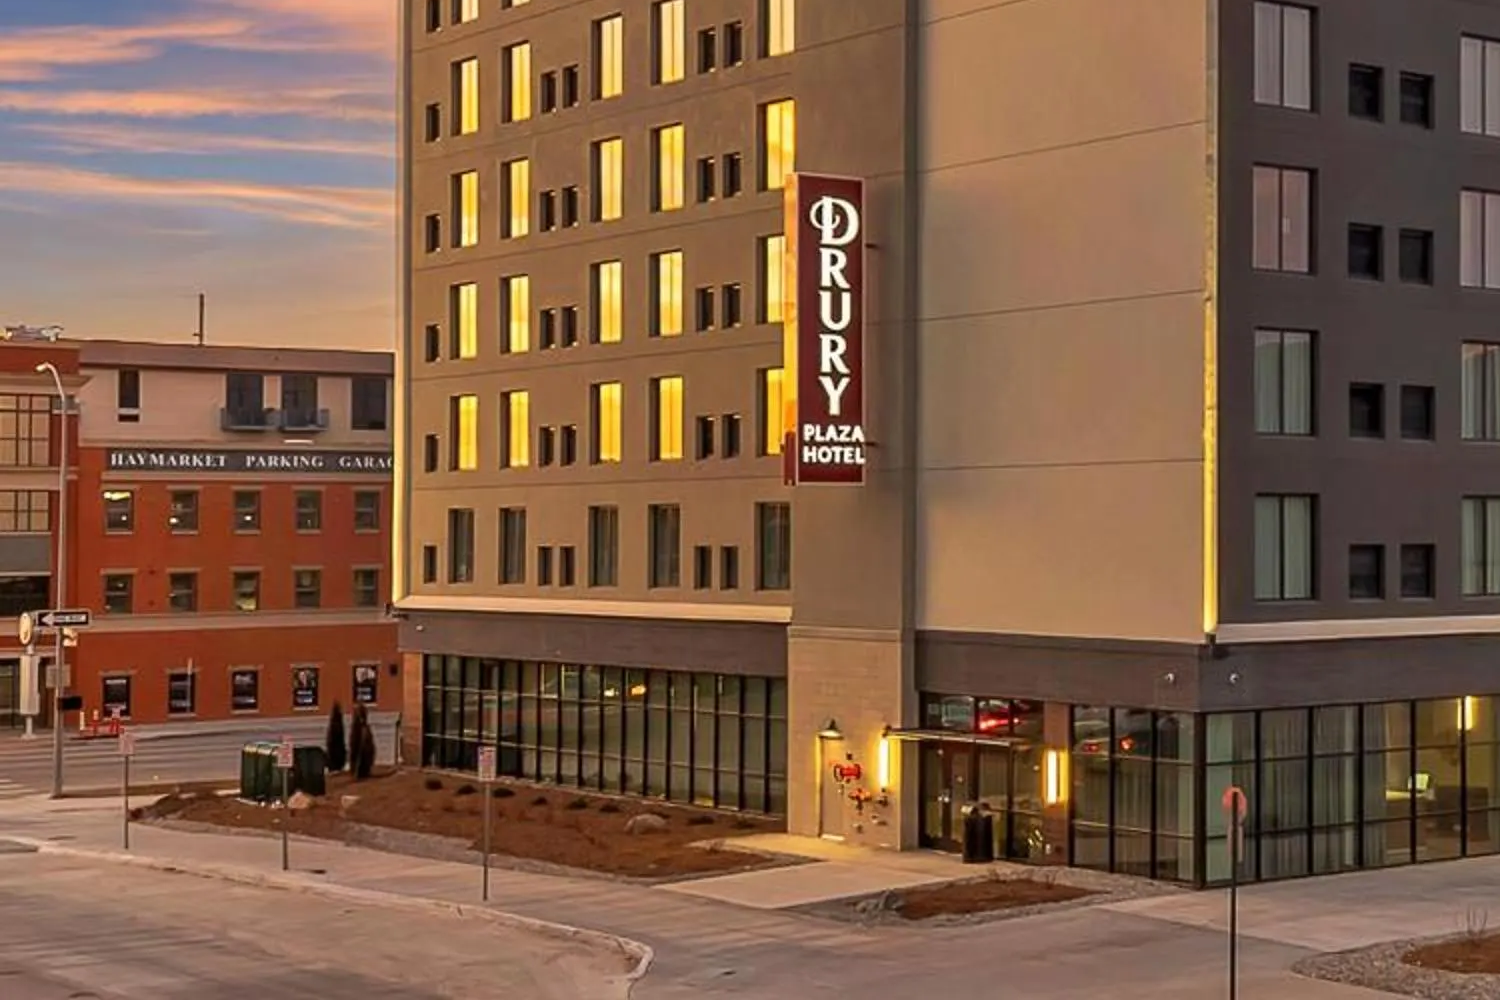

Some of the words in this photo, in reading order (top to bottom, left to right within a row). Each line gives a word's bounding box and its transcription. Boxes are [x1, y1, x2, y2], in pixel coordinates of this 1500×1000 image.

[810, 196, 859, 415] DRURY
[803, 423, 865, 442] PLAZA
[111, 453, 226, 467] HAYMARKET
[246, 455, 323, 468] PARKING
[803, 446, 865, 464] HOTEL
